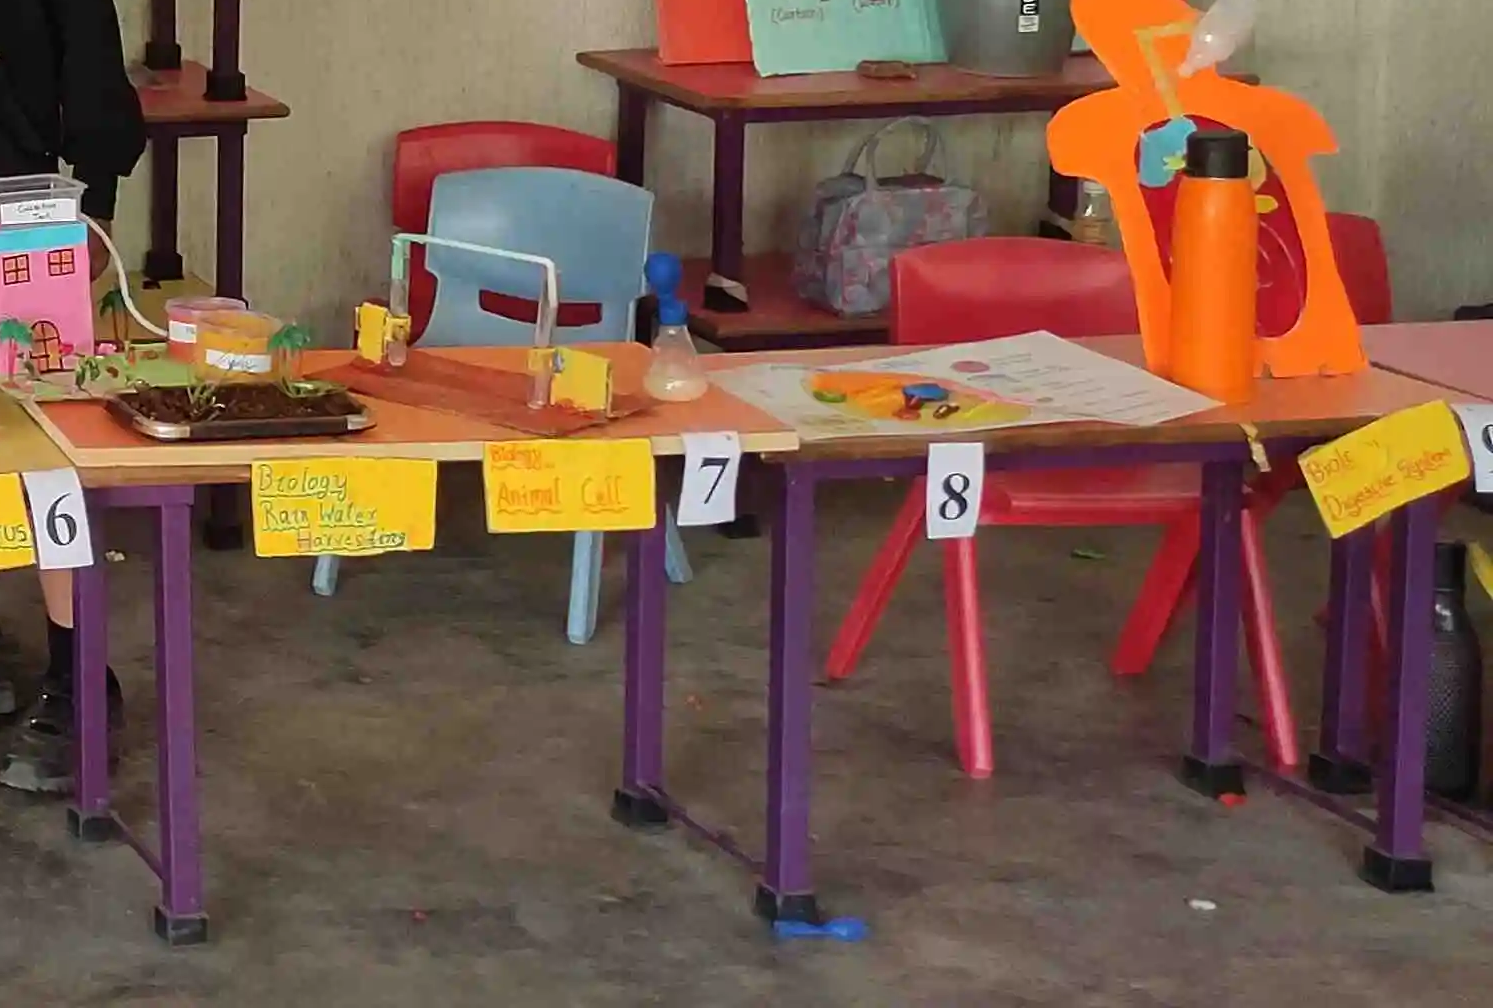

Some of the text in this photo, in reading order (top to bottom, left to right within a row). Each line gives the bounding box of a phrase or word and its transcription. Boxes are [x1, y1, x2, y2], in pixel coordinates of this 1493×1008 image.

[258, 463, 347, 501] Biology
[497, 477, 622, 504] Animal Cell
[697, 458, 728, 504] 7
[939, 473, 970, 520] 8
[47, 493, 76, 546] 6
